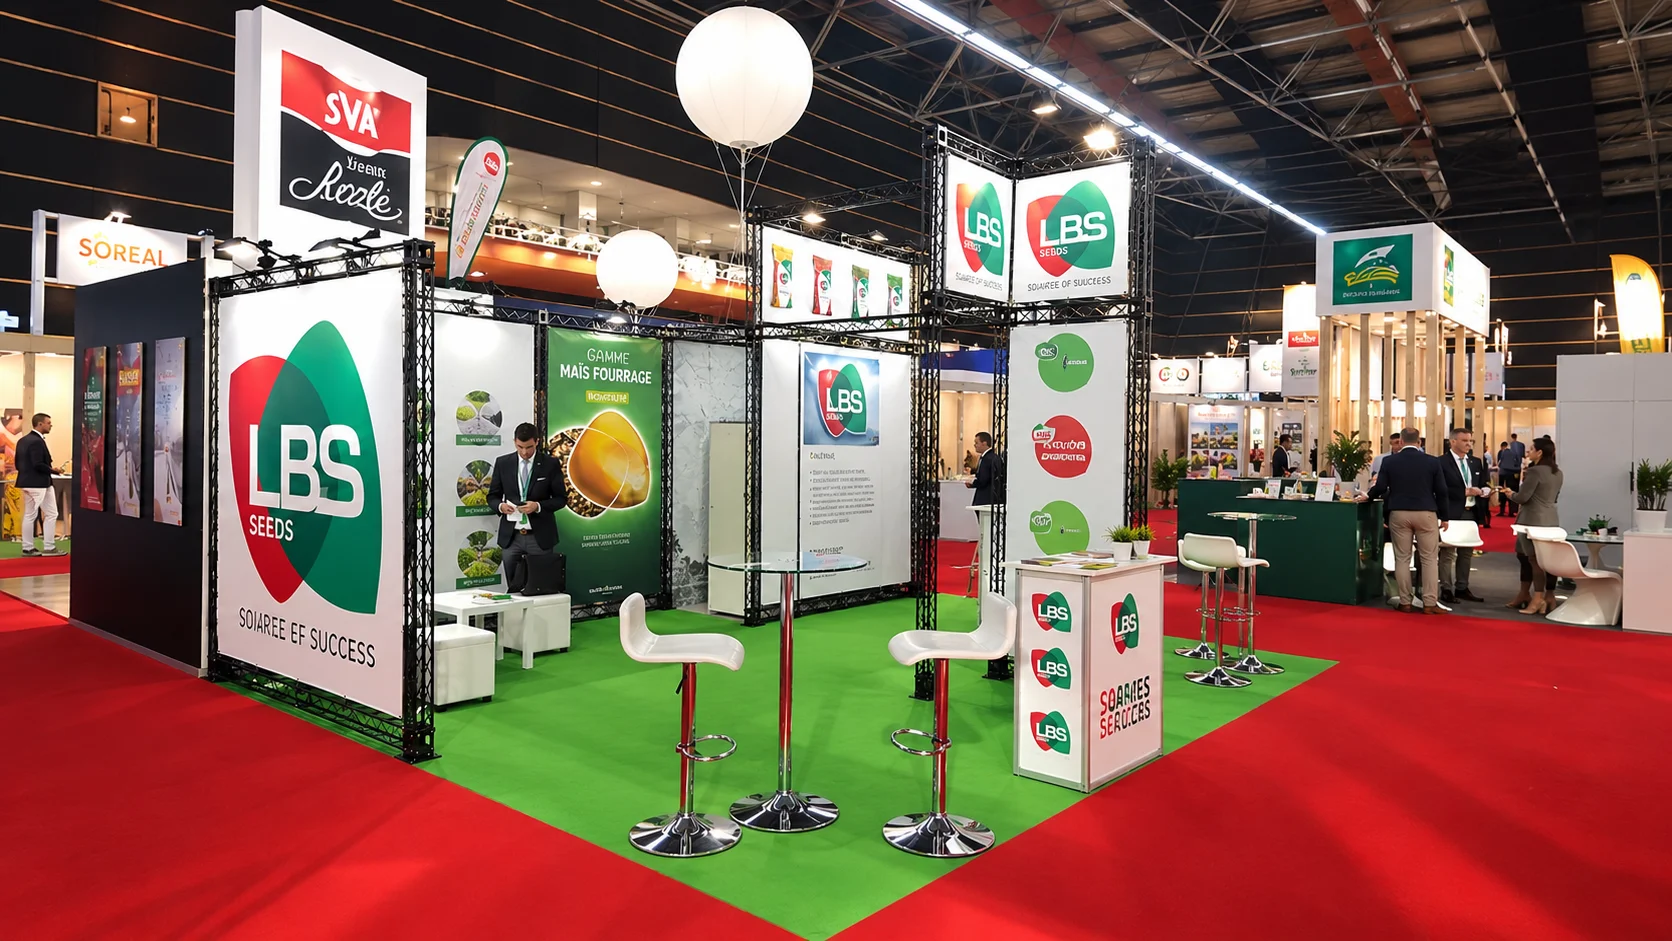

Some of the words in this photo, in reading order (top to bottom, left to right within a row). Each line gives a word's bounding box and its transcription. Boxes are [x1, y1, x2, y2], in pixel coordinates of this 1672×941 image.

[324, 88, 379, 140] SVA
[964, 207, 1002, 248] LBS
[1039, 211, 1108, 248] LBS
[1061, 279, 1071, 288] OF
[587, 347, 630, 365] GAMME
[560, 362, 590, 380] MAÏS
[593, 366, 652, 384] FOURRAGE
[826, 387, 863, 414] LBS
[249, 424, 365, 518] LBS
[249, 513, 294, 542] SEEDS
[1037, 603, 1069, 621] LBS
[1115, 613, 1137, 637] LBS
[310, 627, 376, 668] SUCCESS
[1036, 659, 1068, 678] LBS
[1035, 722, 1068, 742] LBS
